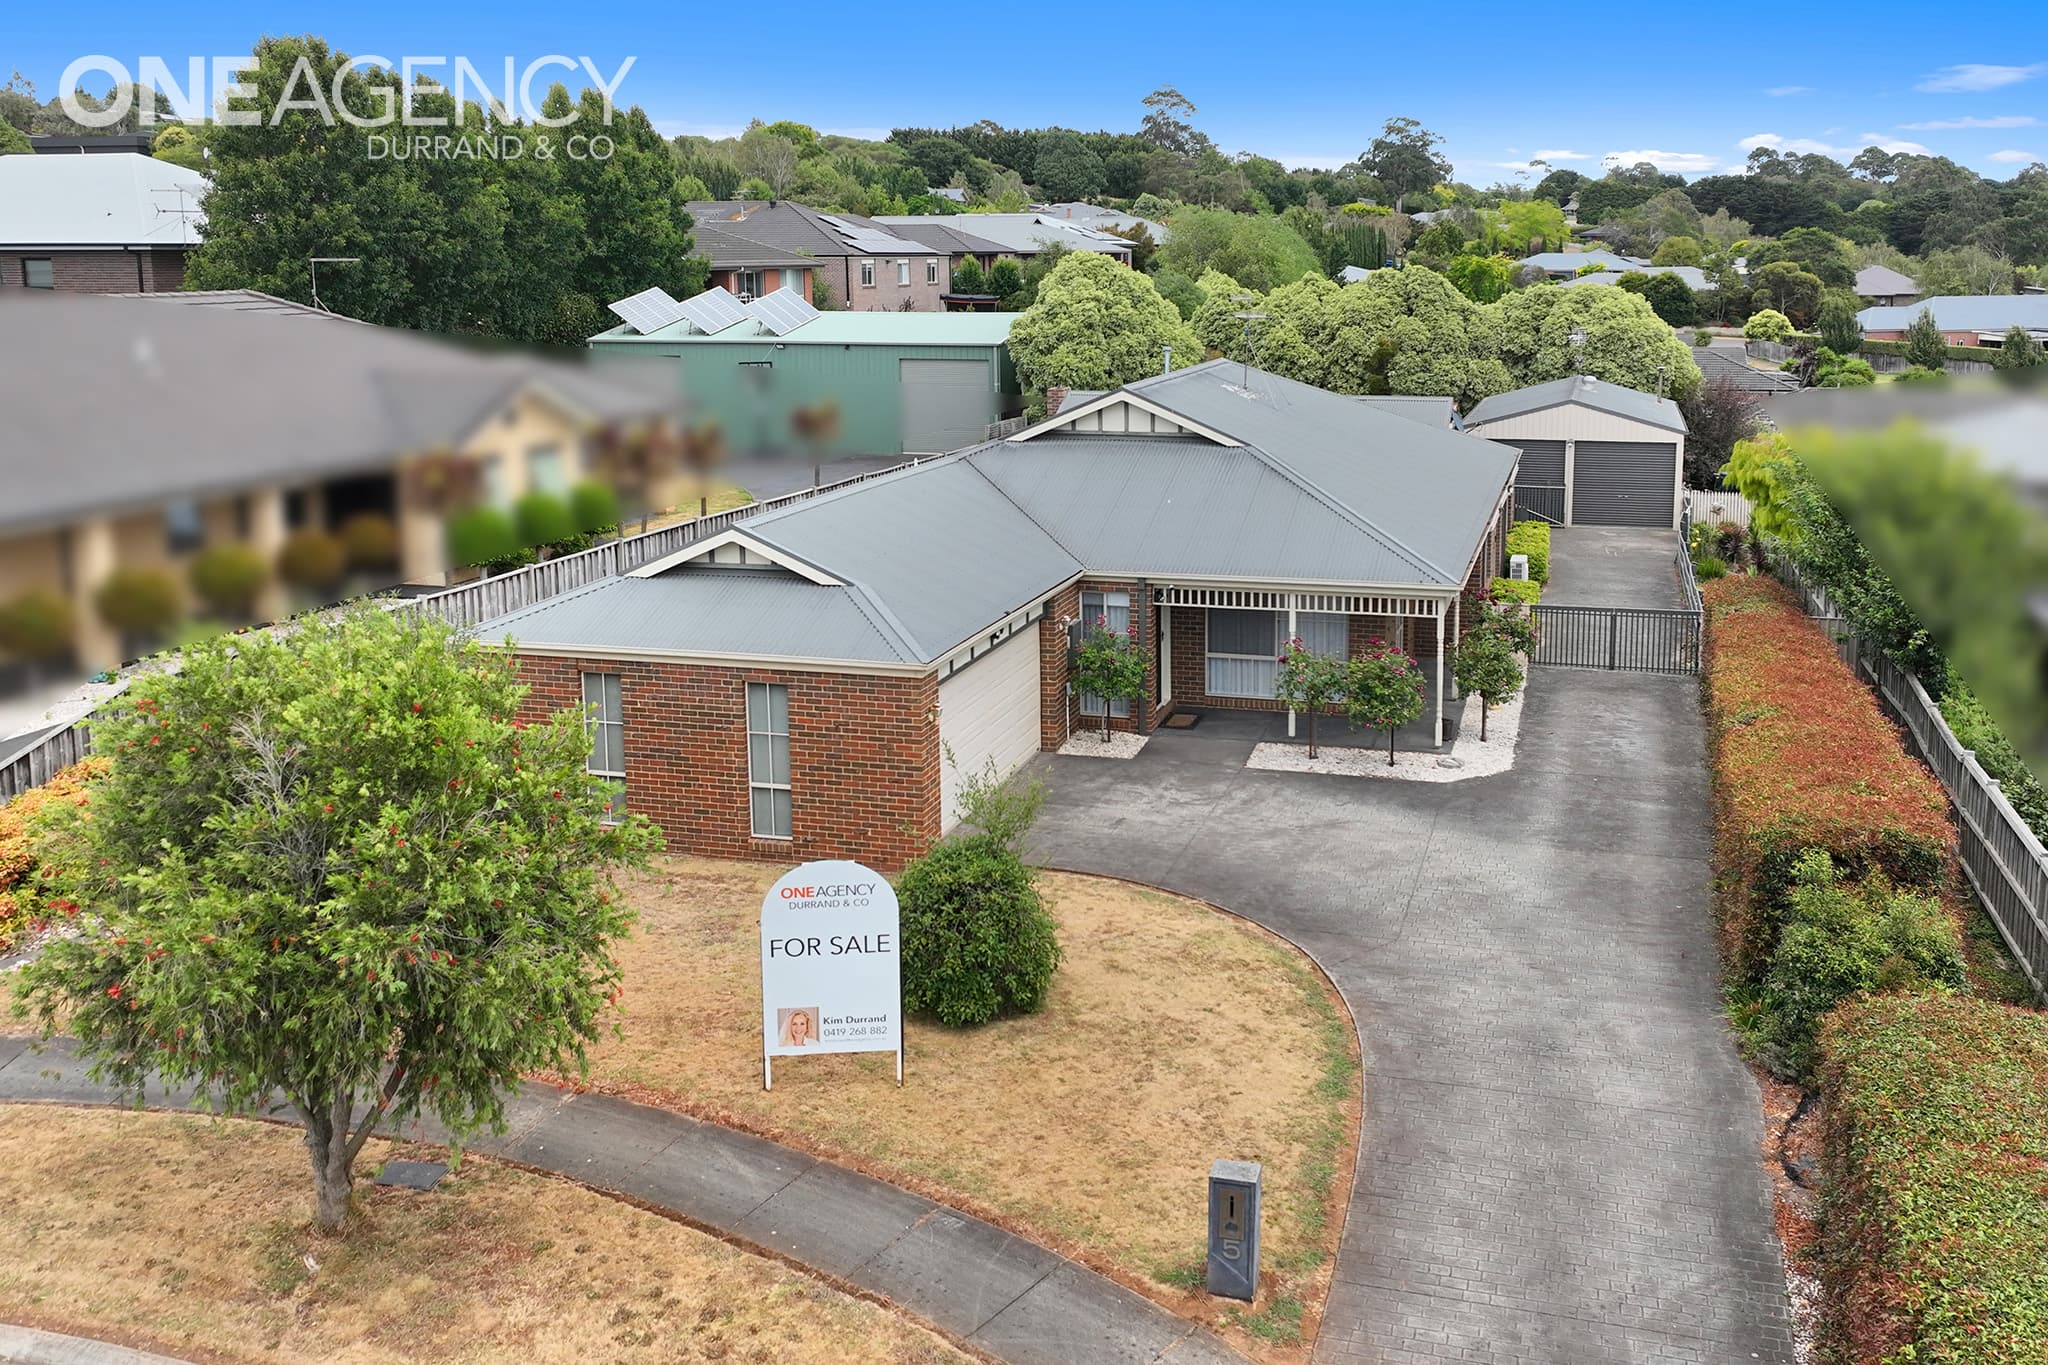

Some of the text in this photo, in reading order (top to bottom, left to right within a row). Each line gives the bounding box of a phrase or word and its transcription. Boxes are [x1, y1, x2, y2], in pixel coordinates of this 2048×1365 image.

[789, 898, 869, 910] DURRAND & CO
[770, 934, 891, 958] FOR SALE
[823, 1014, 887, 1025] Kim Durrand
[823, 1026, 888, 1037] 0419 268 882
[1222, 1239, 1240, 1260] 5
